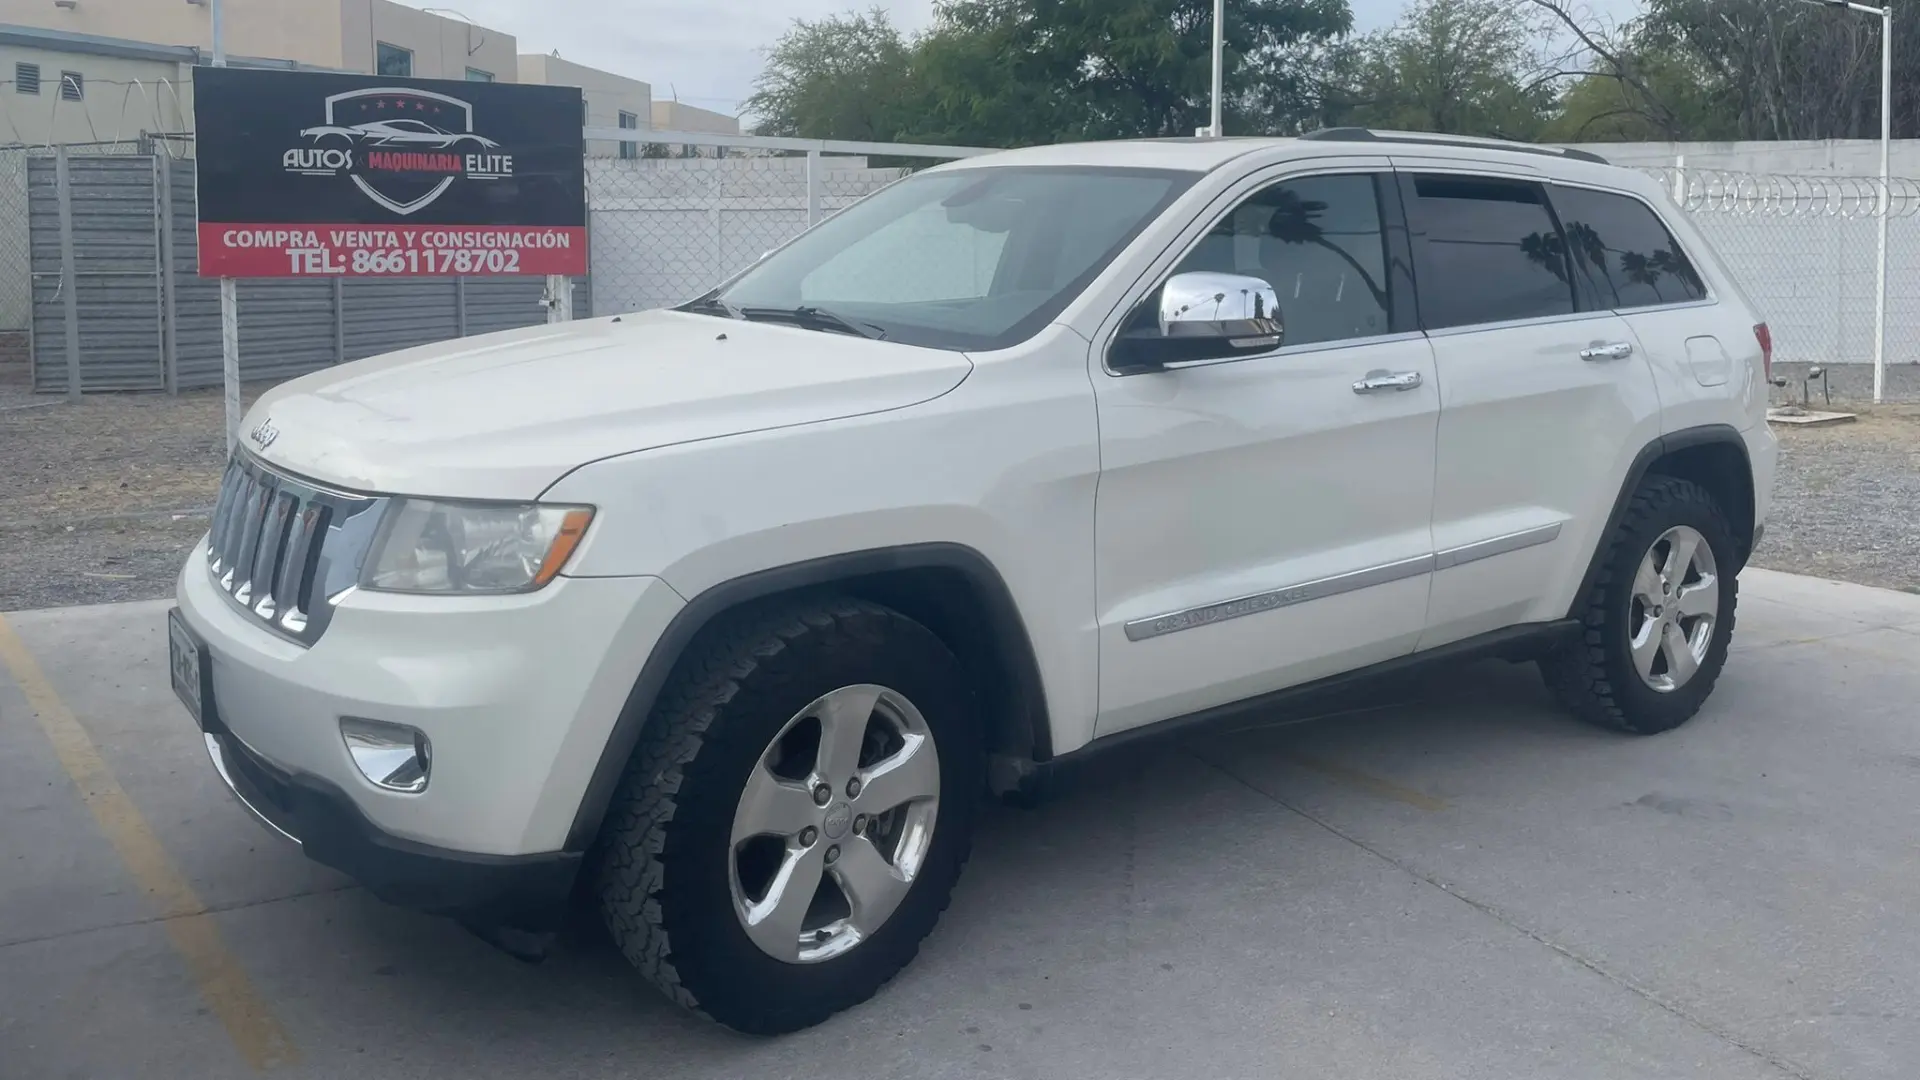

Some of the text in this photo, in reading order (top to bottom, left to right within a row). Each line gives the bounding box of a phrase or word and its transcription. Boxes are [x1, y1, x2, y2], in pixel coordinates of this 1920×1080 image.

[283, 148, 353, 170] AUTOS
[368, 151, 462, 173] MAQUINARIA
[466, 154, 513, 173] ELITE
[223, 229, 570, 250] COMPRA, VENTA Y CONSIGNACIÓN
[285, 248, 520, 273] TEL: 8661178702
[1155, 607, 1218, 632] GRAND
